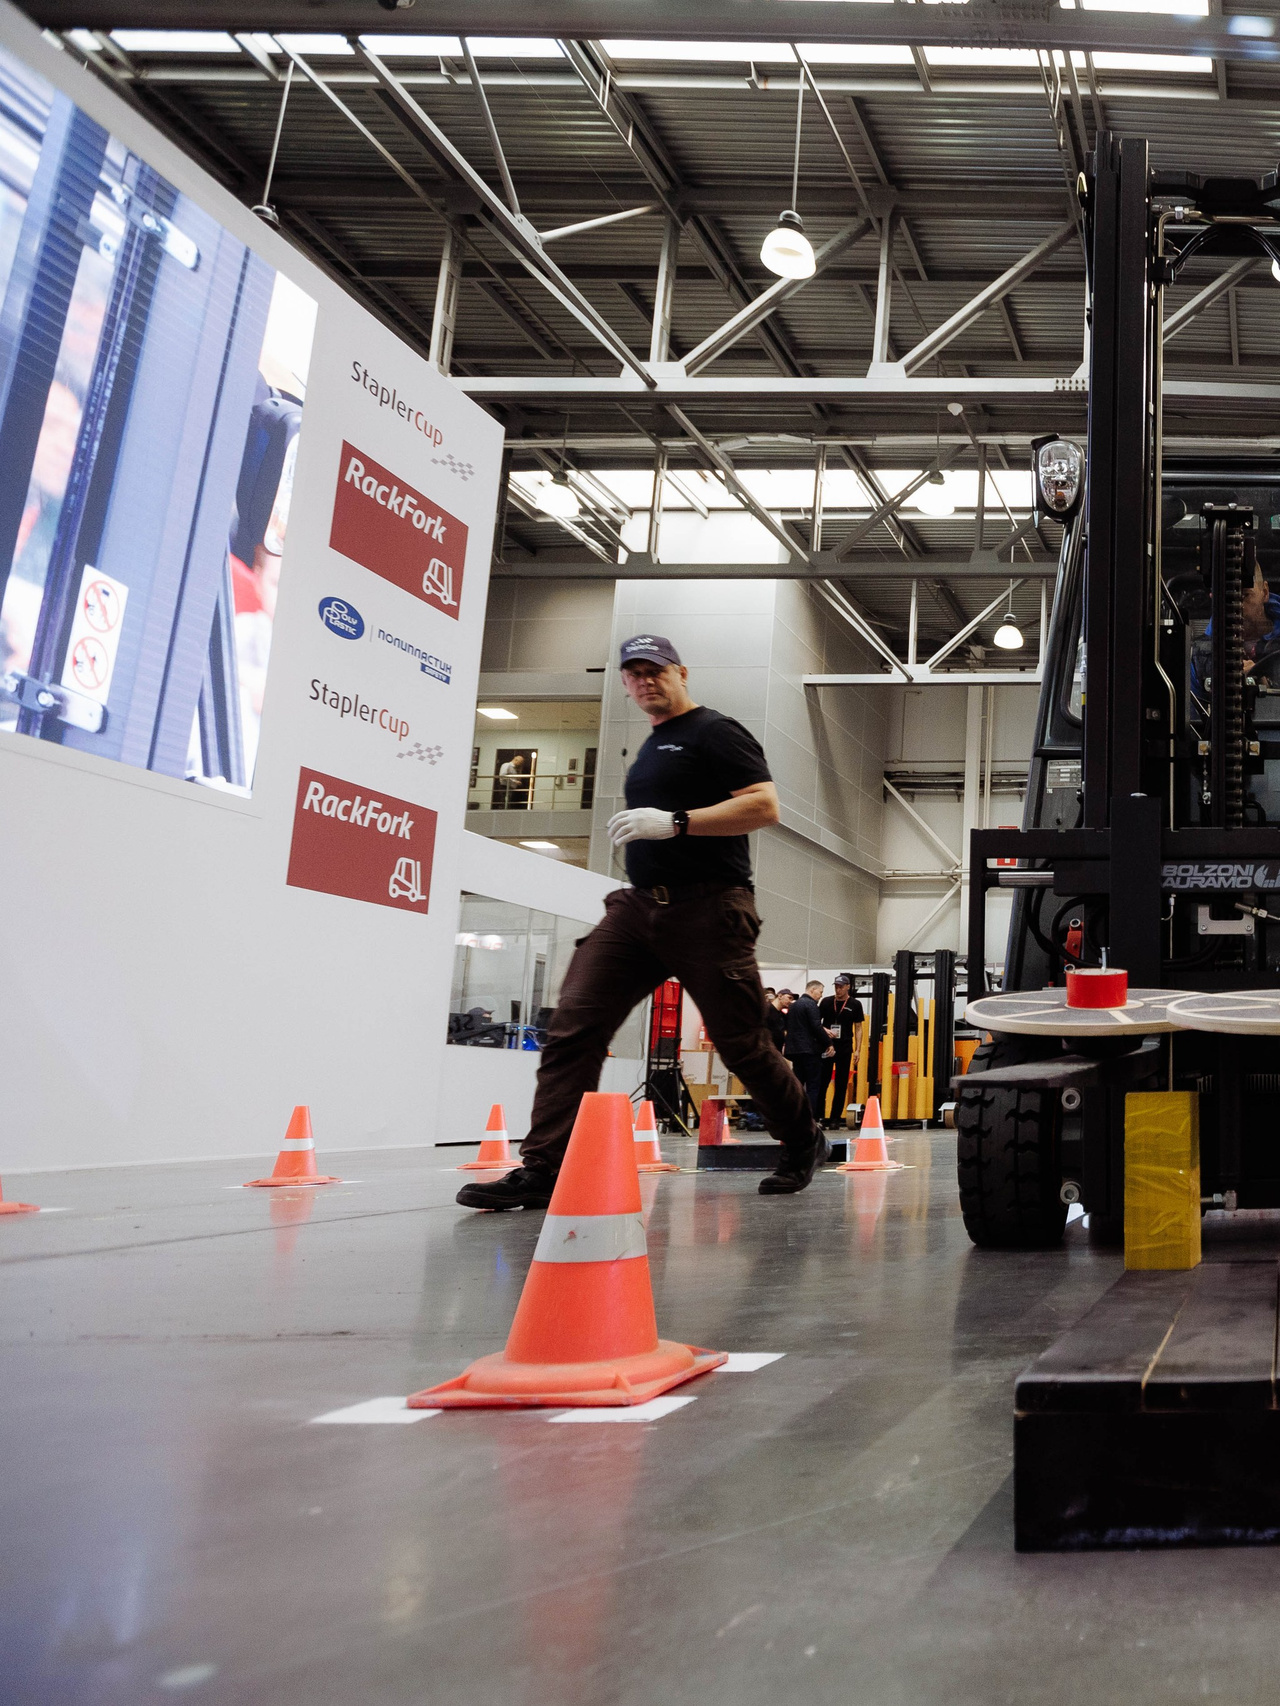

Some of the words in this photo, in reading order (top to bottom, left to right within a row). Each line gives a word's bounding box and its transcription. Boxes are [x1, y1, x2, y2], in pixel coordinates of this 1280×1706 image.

[351, 361, 443, 447] StaplerCup
[344, 457, 448, 544] RackFork
[310, 679, 409, 741] StaplerCup
[303, 781, 414, 840] RackFork
[1161, 864, 1253, 876] BOLZONI
[1161, 876, 1252, 888] AURAMO
